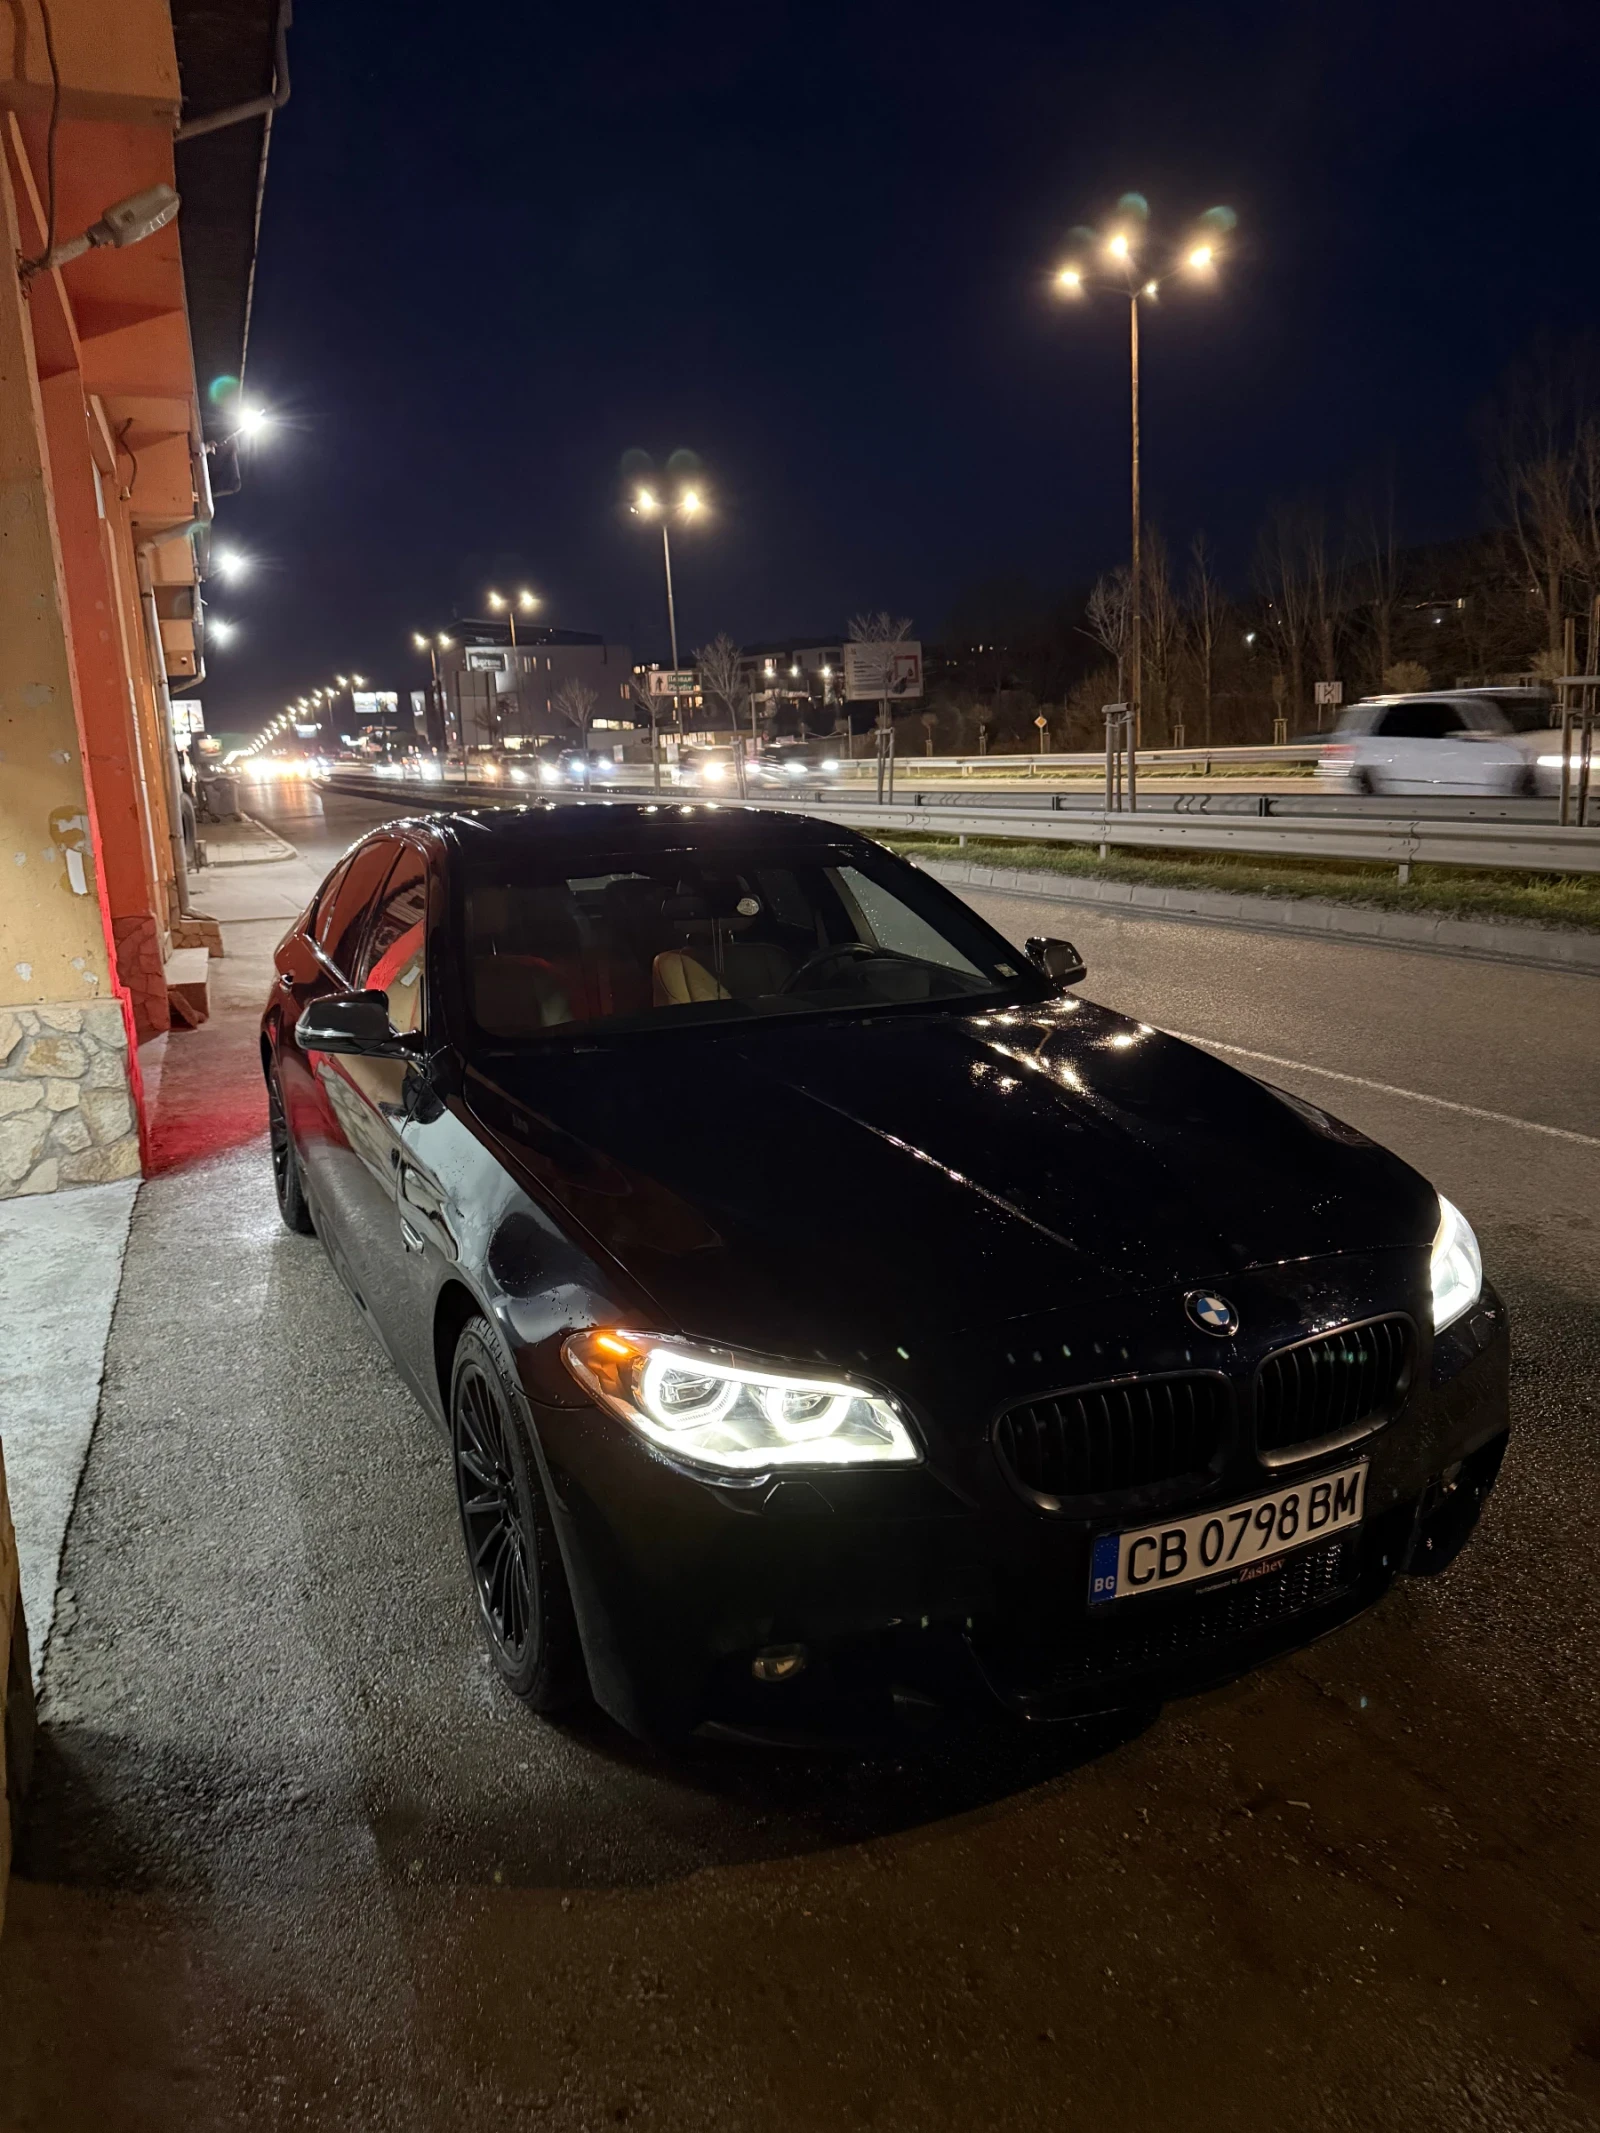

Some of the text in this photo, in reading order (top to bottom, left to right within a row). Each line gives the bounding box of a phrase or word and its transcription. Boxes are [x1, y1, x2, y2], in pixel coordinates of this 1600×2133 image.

[1127, 1471, 1361, 1586] CB 0798 BM
[1239, 1557, 1287, 1583] Zashev
[1094, 1575, 1115, 1593] BG
